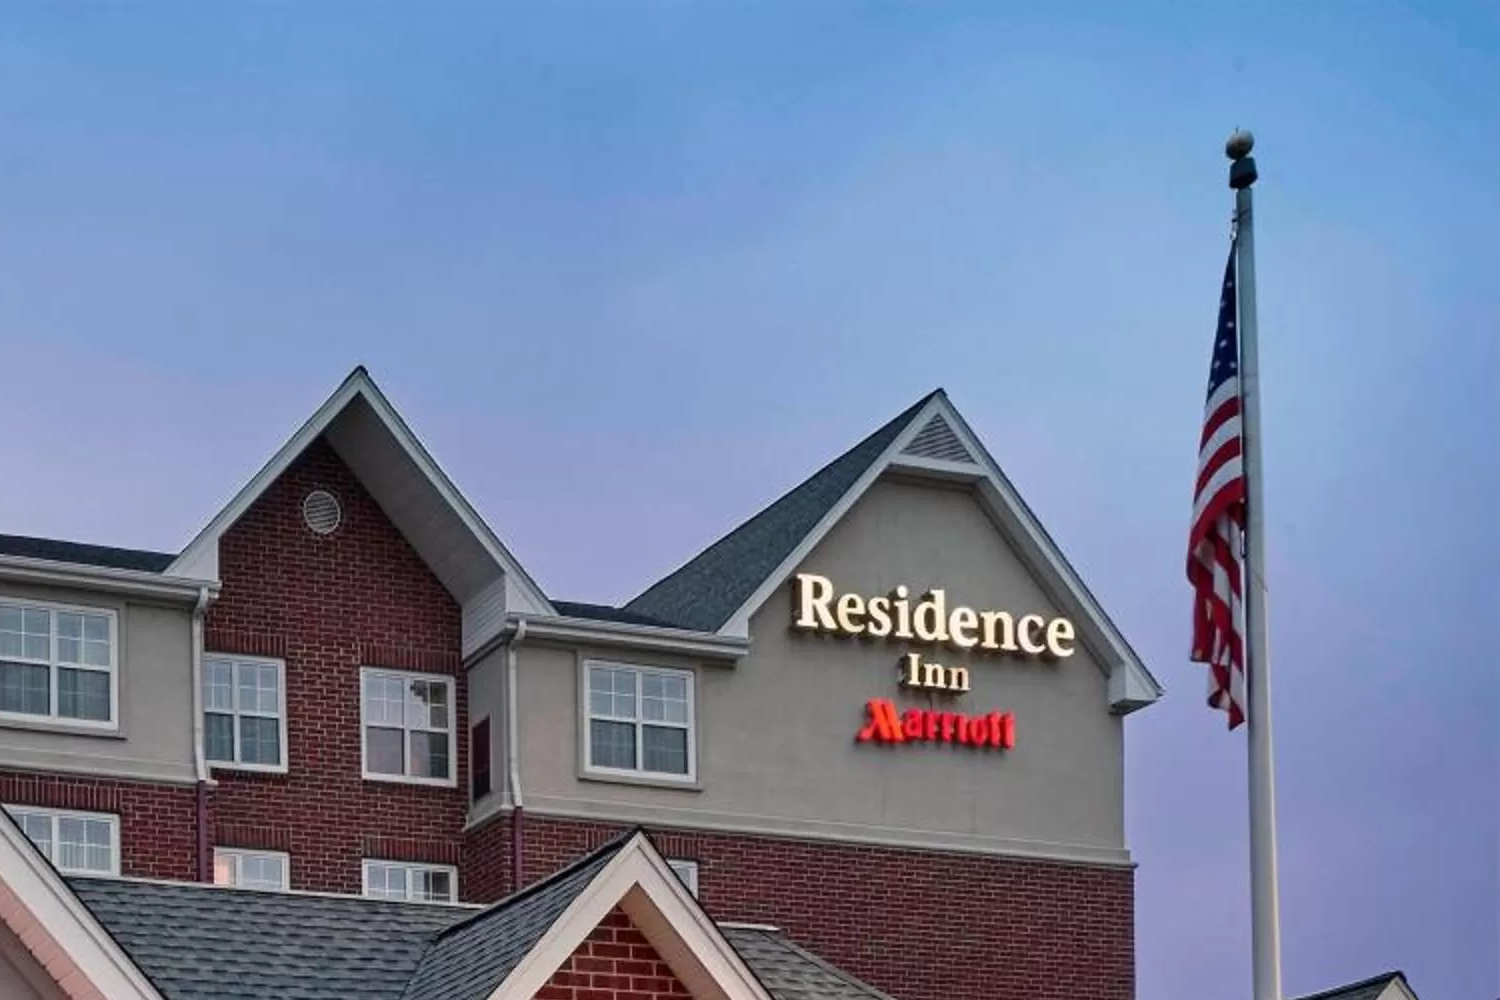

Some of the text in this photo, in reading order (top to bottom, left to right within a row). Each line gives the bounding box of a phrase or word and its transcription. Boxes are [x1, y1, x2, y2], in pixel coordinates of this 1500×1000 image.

[796, 573, 1076, 658] Residence
[906, 652, 971, 691] Inn
[855, 697, 1015, 749] Marriott
